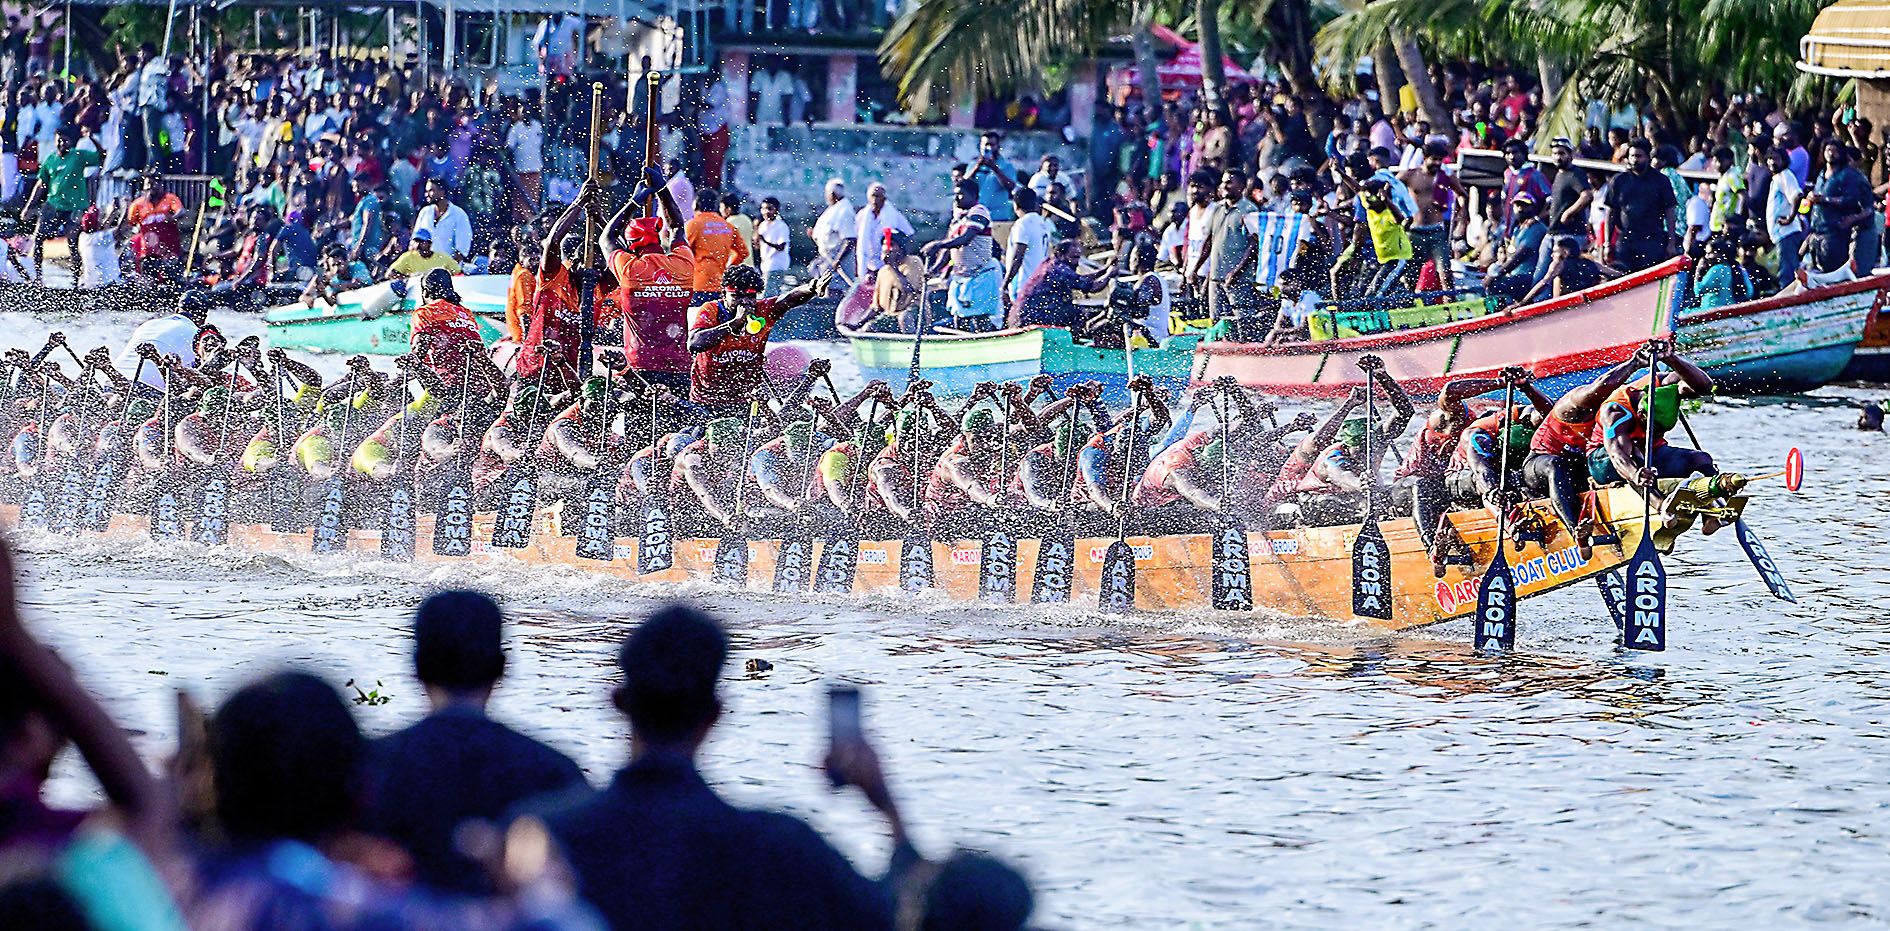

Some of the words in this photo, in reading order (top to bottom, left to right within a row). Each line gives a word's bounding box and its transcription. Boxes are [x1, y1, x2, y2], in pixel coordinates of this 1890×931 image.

[1269, 234, 1284, 254] 10
[1788, 453, 1797, 487] 1
[445, 486, 470, 551] AROMA
[585, 488, 609, 553] AROMA
[645, 508, 668, 570] AROMA
[1249, 542, 1273, 556] ROMA
[1273, 539, 1298, 554] GROUP
[781, 542, 803, 593] AROM
[864, 550, 887, 563] GROUP
[907, 545, 928, 591] ARO
[1042, 543, 1068, 603] AROM
[1110, 560, 1128, 613] ARO
[1223, 529, 1247, 602] AROMA
[1361, 541, 1382, 609] AROMA
[1455, 578, 1482, 604] ARO
[1511, 558, 1546, 587] BOAT
[1744, 530, 1795, 602] AROMA
[1483, 576, 1508, 650] AROMA
[1634, 561, 1661, 644] AROMA
